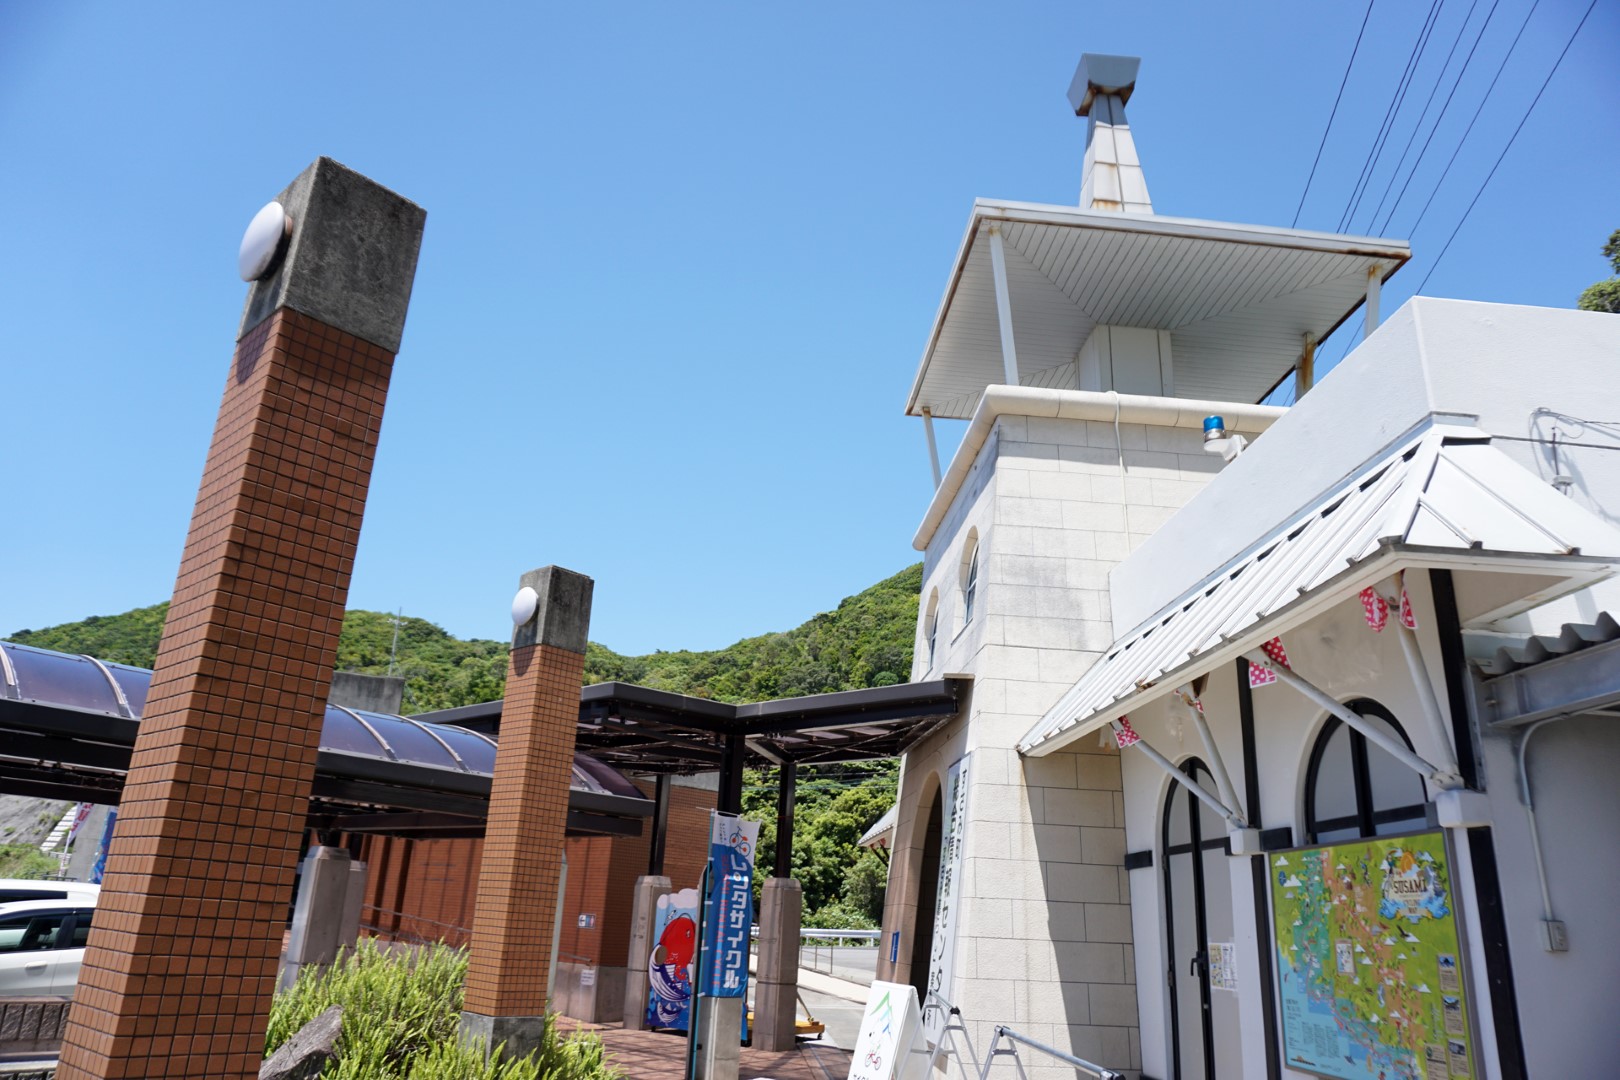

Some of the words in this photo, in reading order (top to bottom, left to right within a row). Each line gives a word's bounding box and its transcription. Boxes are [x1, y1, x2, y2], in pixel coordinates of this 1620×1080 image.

[1393, 879, 1428, 894] SUSAMI
[716, 899, 728, 943] RENTAL
[723, 854, 749, 989] レンタサイクル
